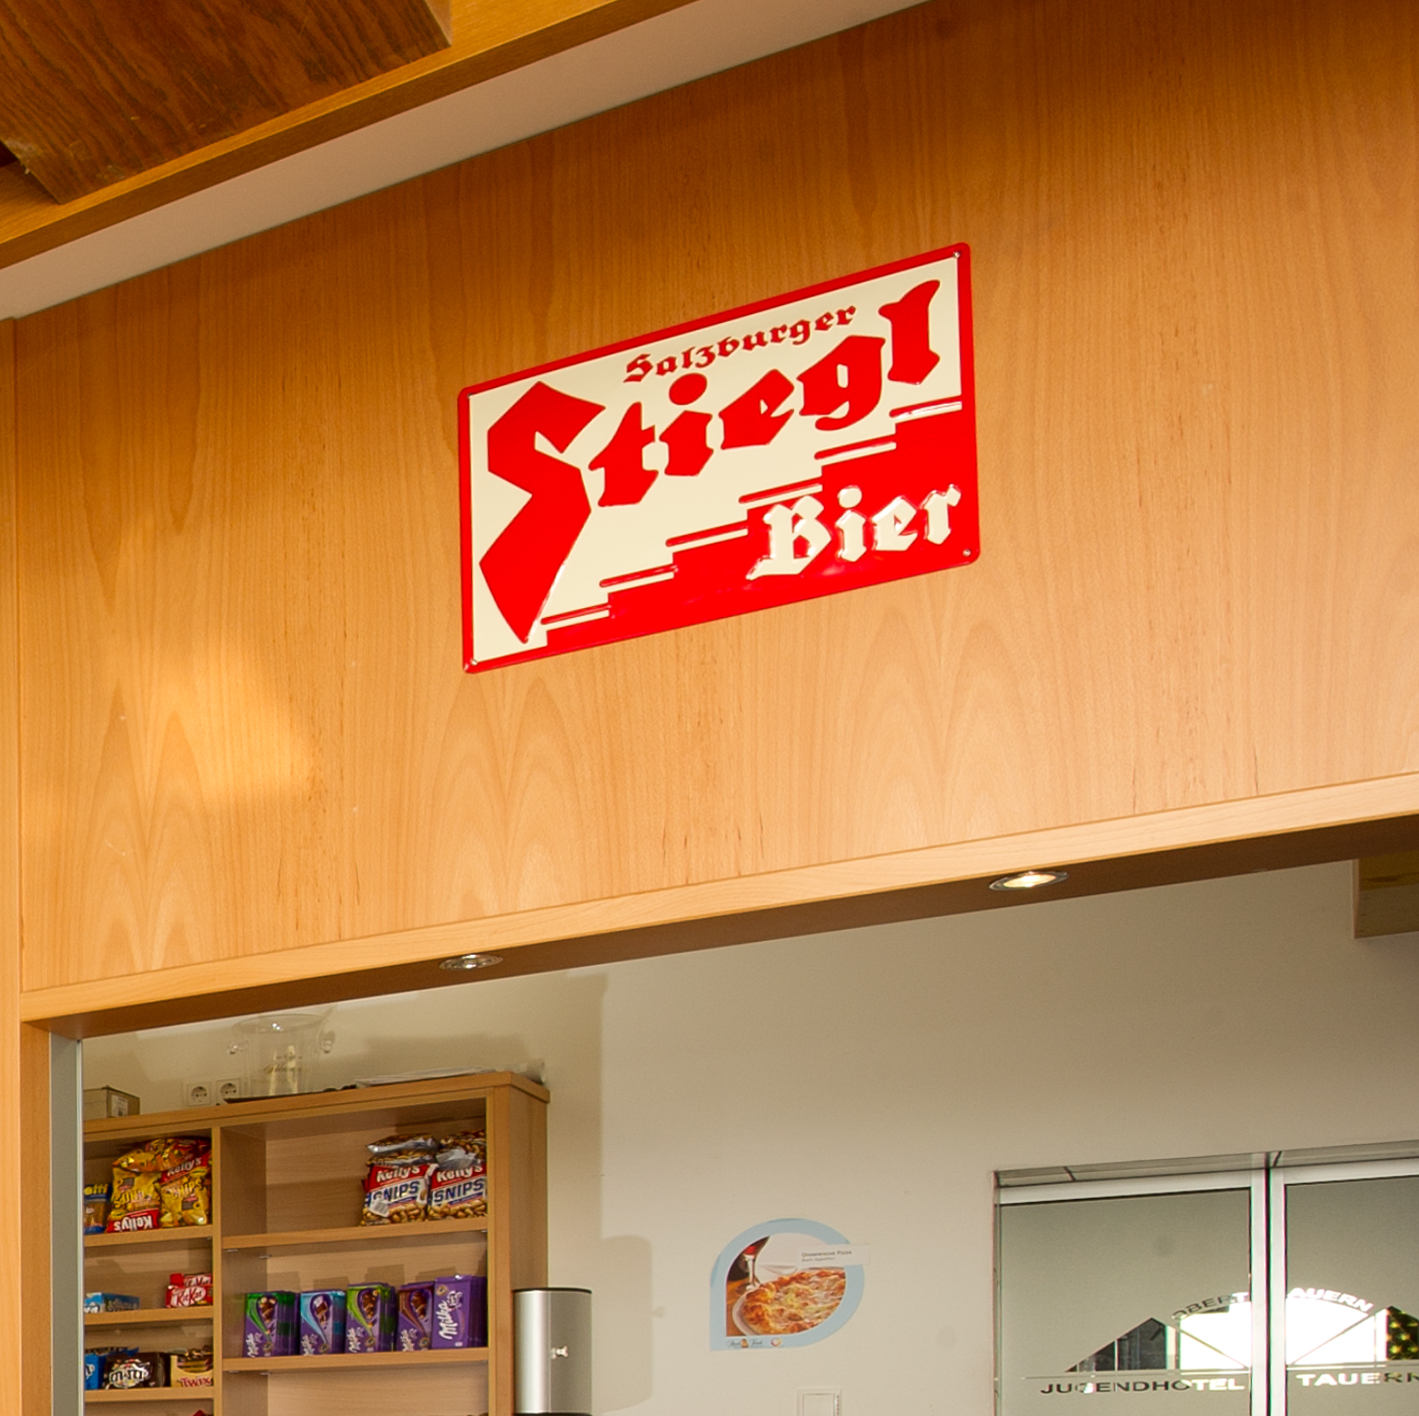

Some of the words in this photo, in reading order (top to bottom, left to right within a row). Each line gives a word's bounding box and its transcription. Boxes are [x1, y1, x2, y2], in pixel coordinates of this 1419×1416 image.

[623, 305, 856, 383] Salzburger
[479, 279, 941, 644] Stiegl
[746, 484, 961, 581] Bier
[434, 1178, 484, 1204] SNIPS
[436, 1300, 459, 1340] Milka
[1040, 1378, 1245, 1394] JUGENDHOTEL
